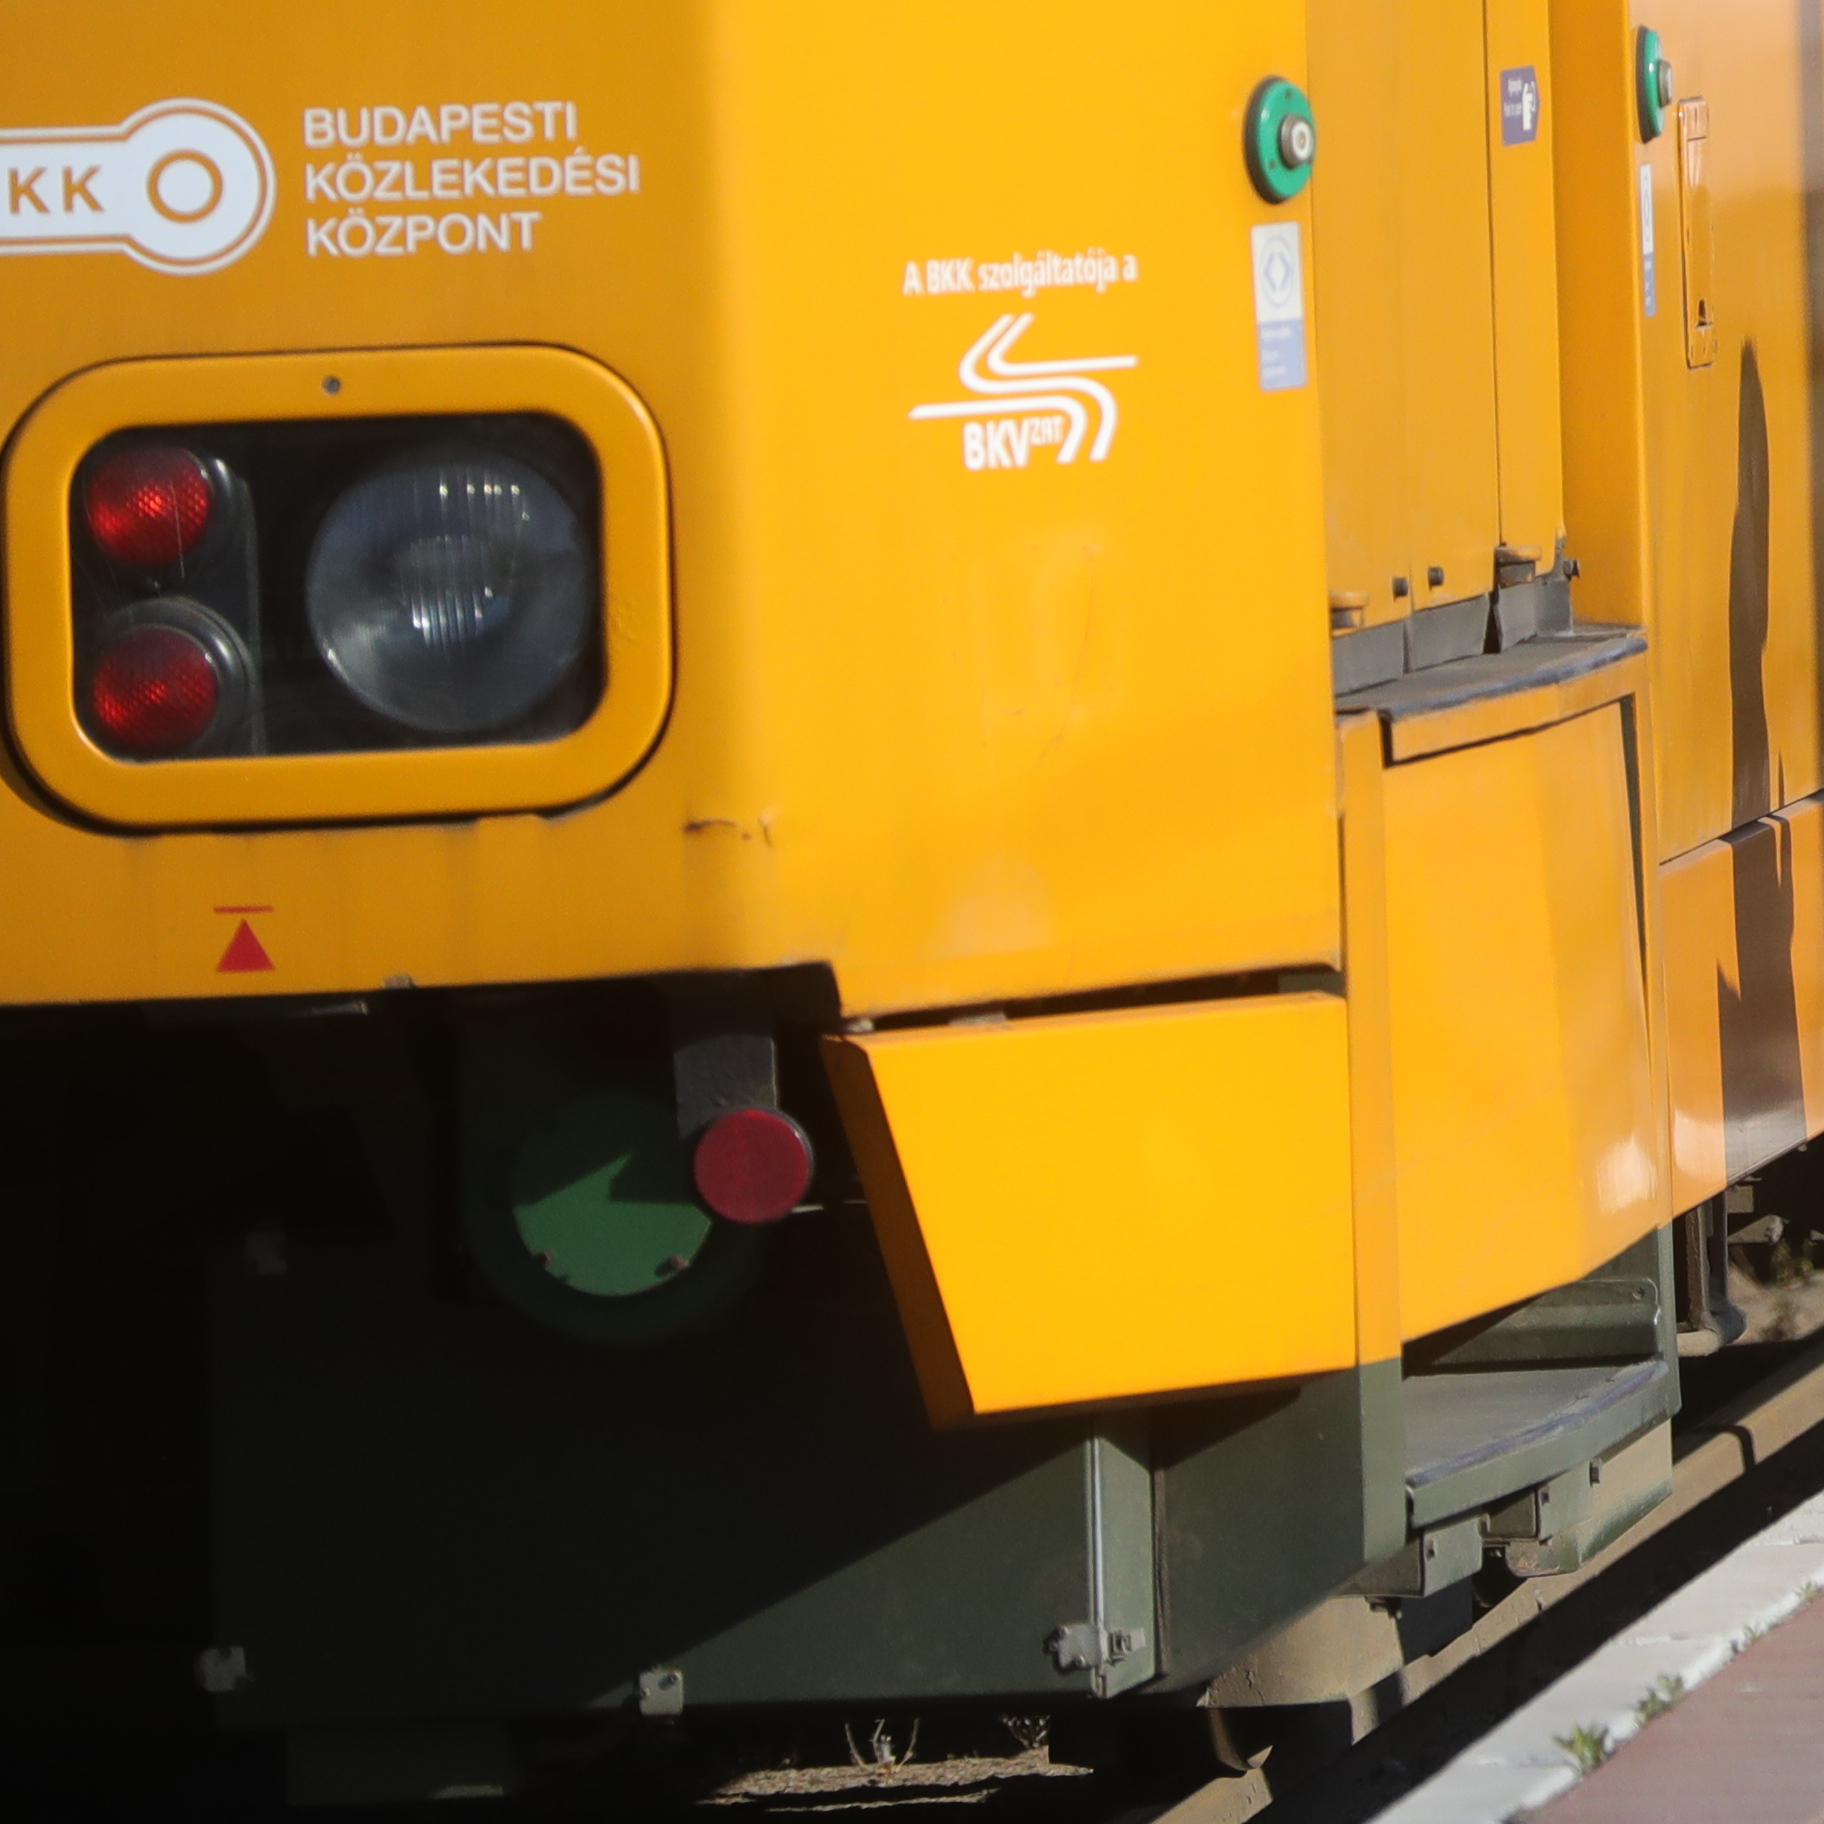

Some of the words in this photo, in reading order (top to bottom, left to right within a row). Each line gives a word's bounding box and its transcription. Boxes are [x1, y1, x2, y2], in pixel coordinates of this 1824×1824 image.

[303, 100, 578, 149] BUDAPESTI
[304, 145, 641, 203] KÖZLEKEDÉSI
[305, 206, 543, 258] KÖZPONT
[902, 260, 924, 296] A
[926, 257, 975, 296] BKK
[977, 246, 1119, 299] szolgáltatója
[1122, 253, 1139, 282] a
[962, 419, 1031, 472] BKV
